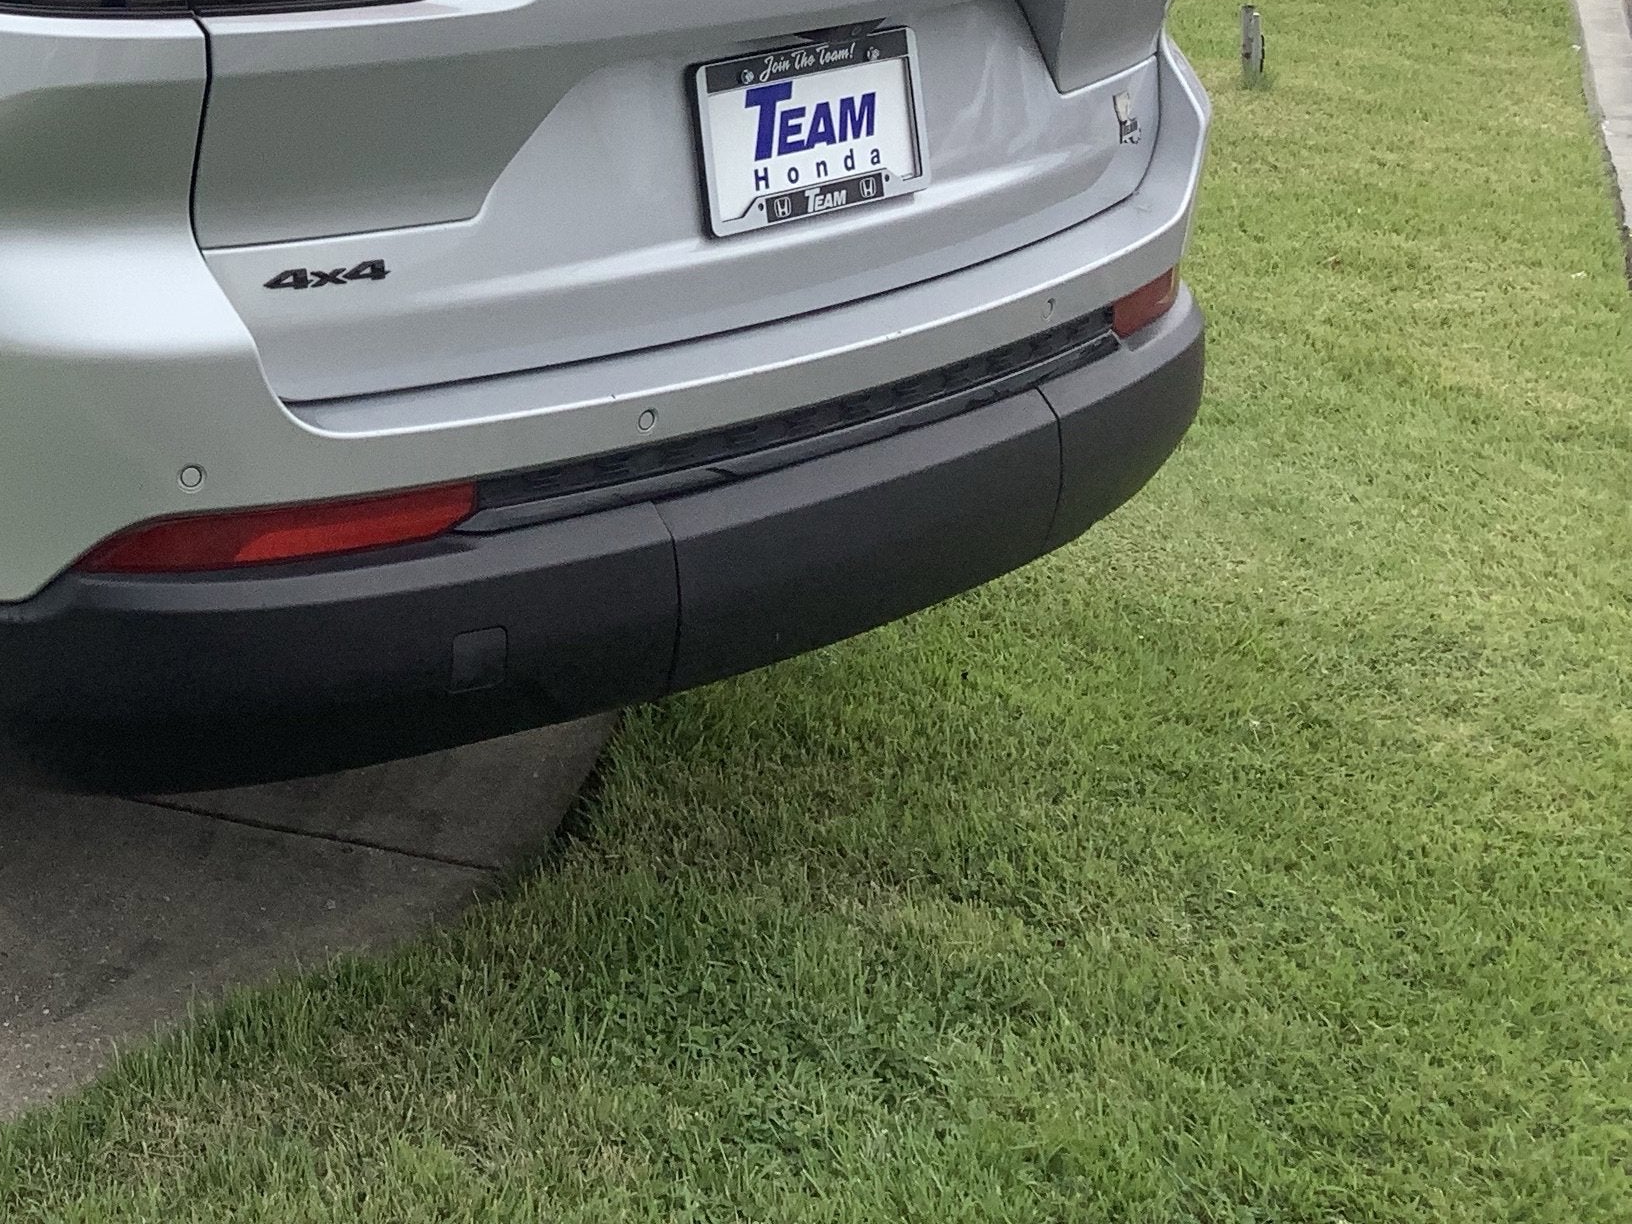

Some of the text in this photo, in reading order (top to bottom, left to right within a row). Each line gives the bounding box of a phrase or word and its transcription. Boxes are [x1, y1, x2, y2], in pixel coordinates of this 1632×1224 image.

[759, 42, 857, 82] Join The Team!
[754, 148, 881, 191] Honda
[263, 258, 392, 290] 4x4
